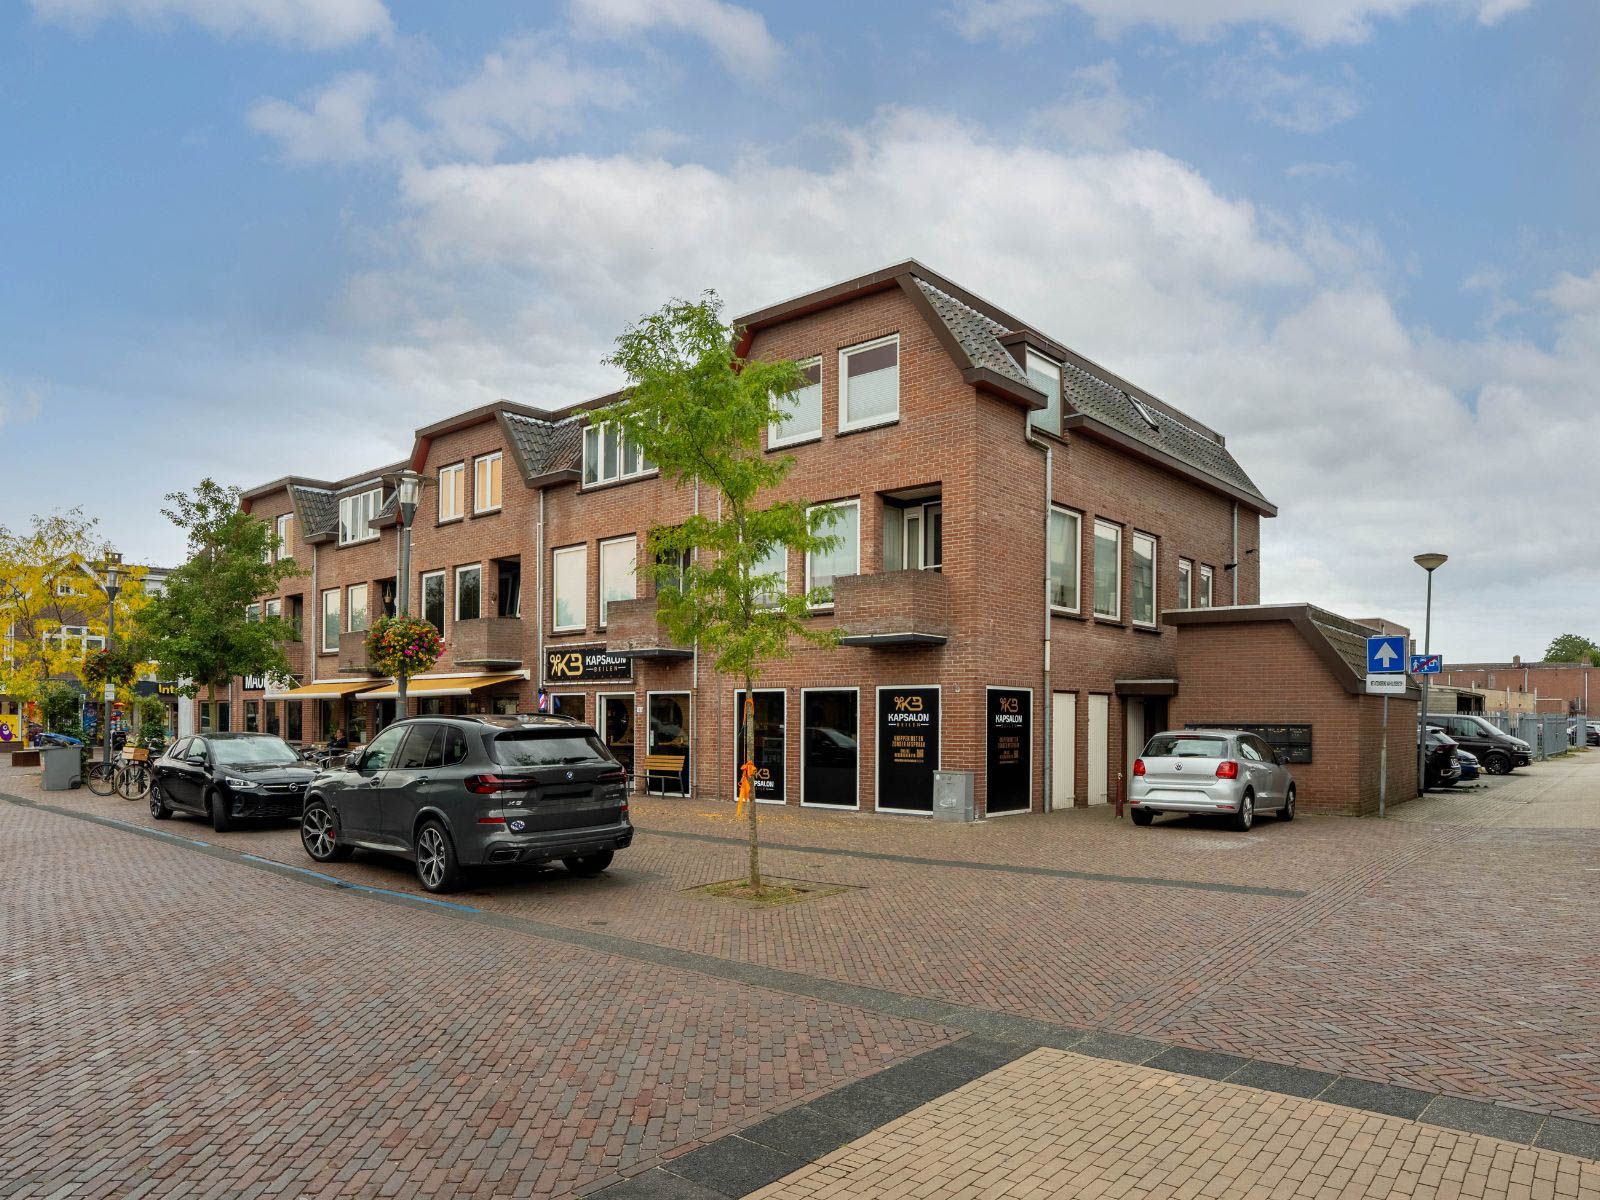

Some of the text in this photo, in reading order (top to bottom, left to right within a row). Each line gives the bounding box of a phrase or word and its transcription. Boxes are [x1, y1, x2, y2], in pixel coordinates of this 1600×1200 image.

[158, 683, 177, 694] Int
[888, 713, 930, 722] KAPSALON
[995, 714, 1023, 723] KAPSALON
